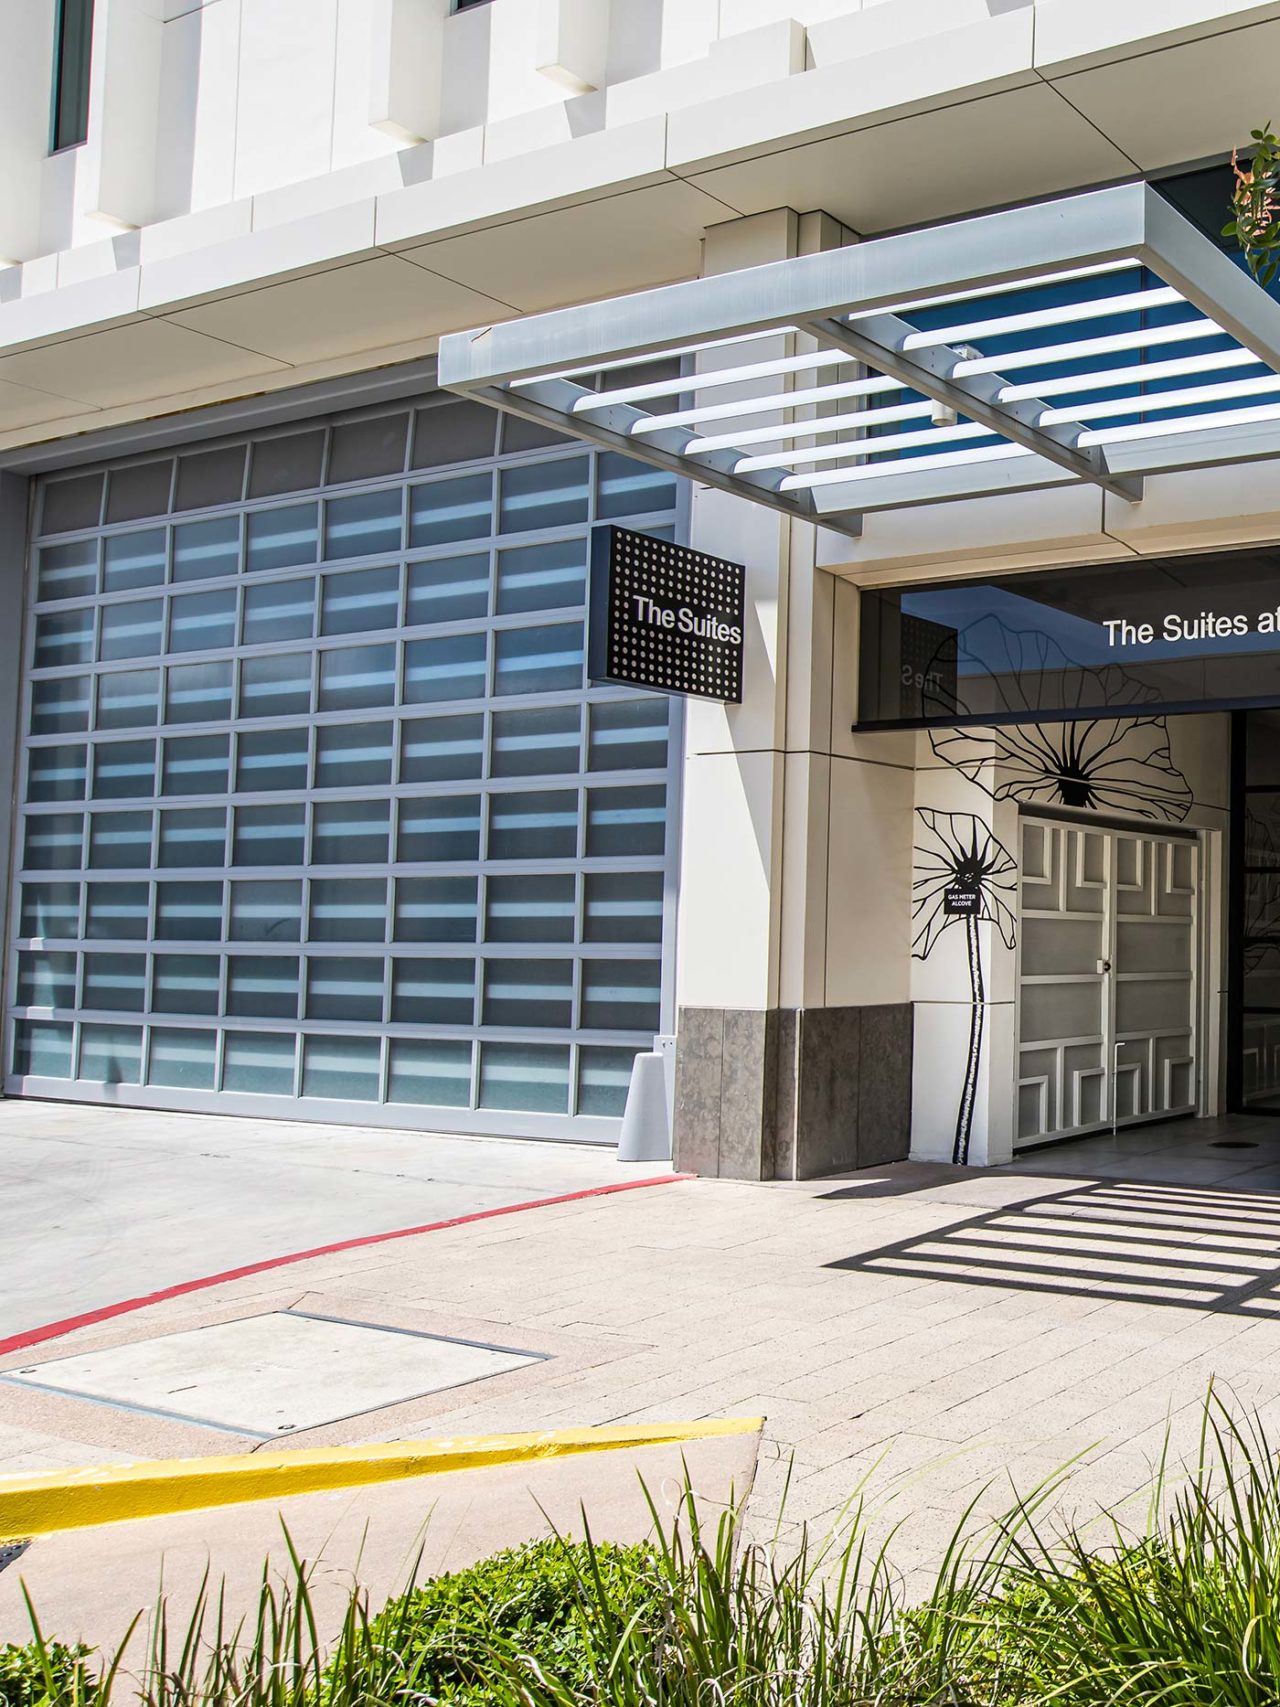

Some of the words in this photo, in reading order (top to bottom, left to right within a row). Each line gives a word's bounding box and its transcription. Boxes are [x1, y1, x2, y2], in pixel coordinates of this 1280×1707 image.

[632, 595, 675, 628] The
[678, 608, 741, 644] Suites
[1103, 619, 1154, 646] The
[1162, 611, 1249, 642] Suites
